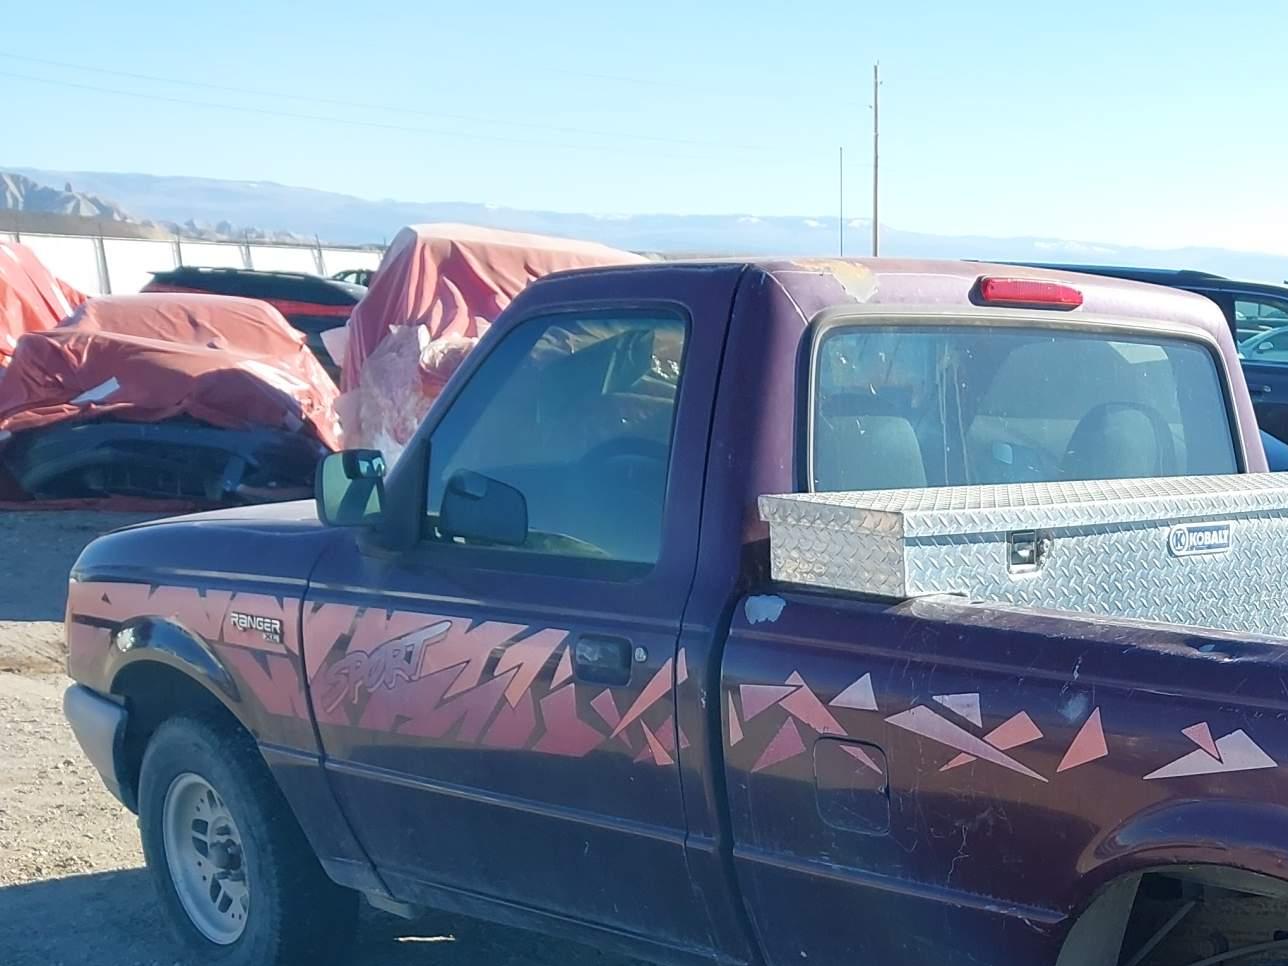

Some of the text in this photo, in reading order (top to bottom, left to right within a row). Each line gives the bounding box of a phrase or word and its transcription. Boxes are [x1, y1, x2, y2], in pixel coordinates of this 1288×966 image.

[1189, 529, 1230, 547] KOBALT
[230, 610, 282, 635] RANGER
[321, 618, 454, 714] SPORT
